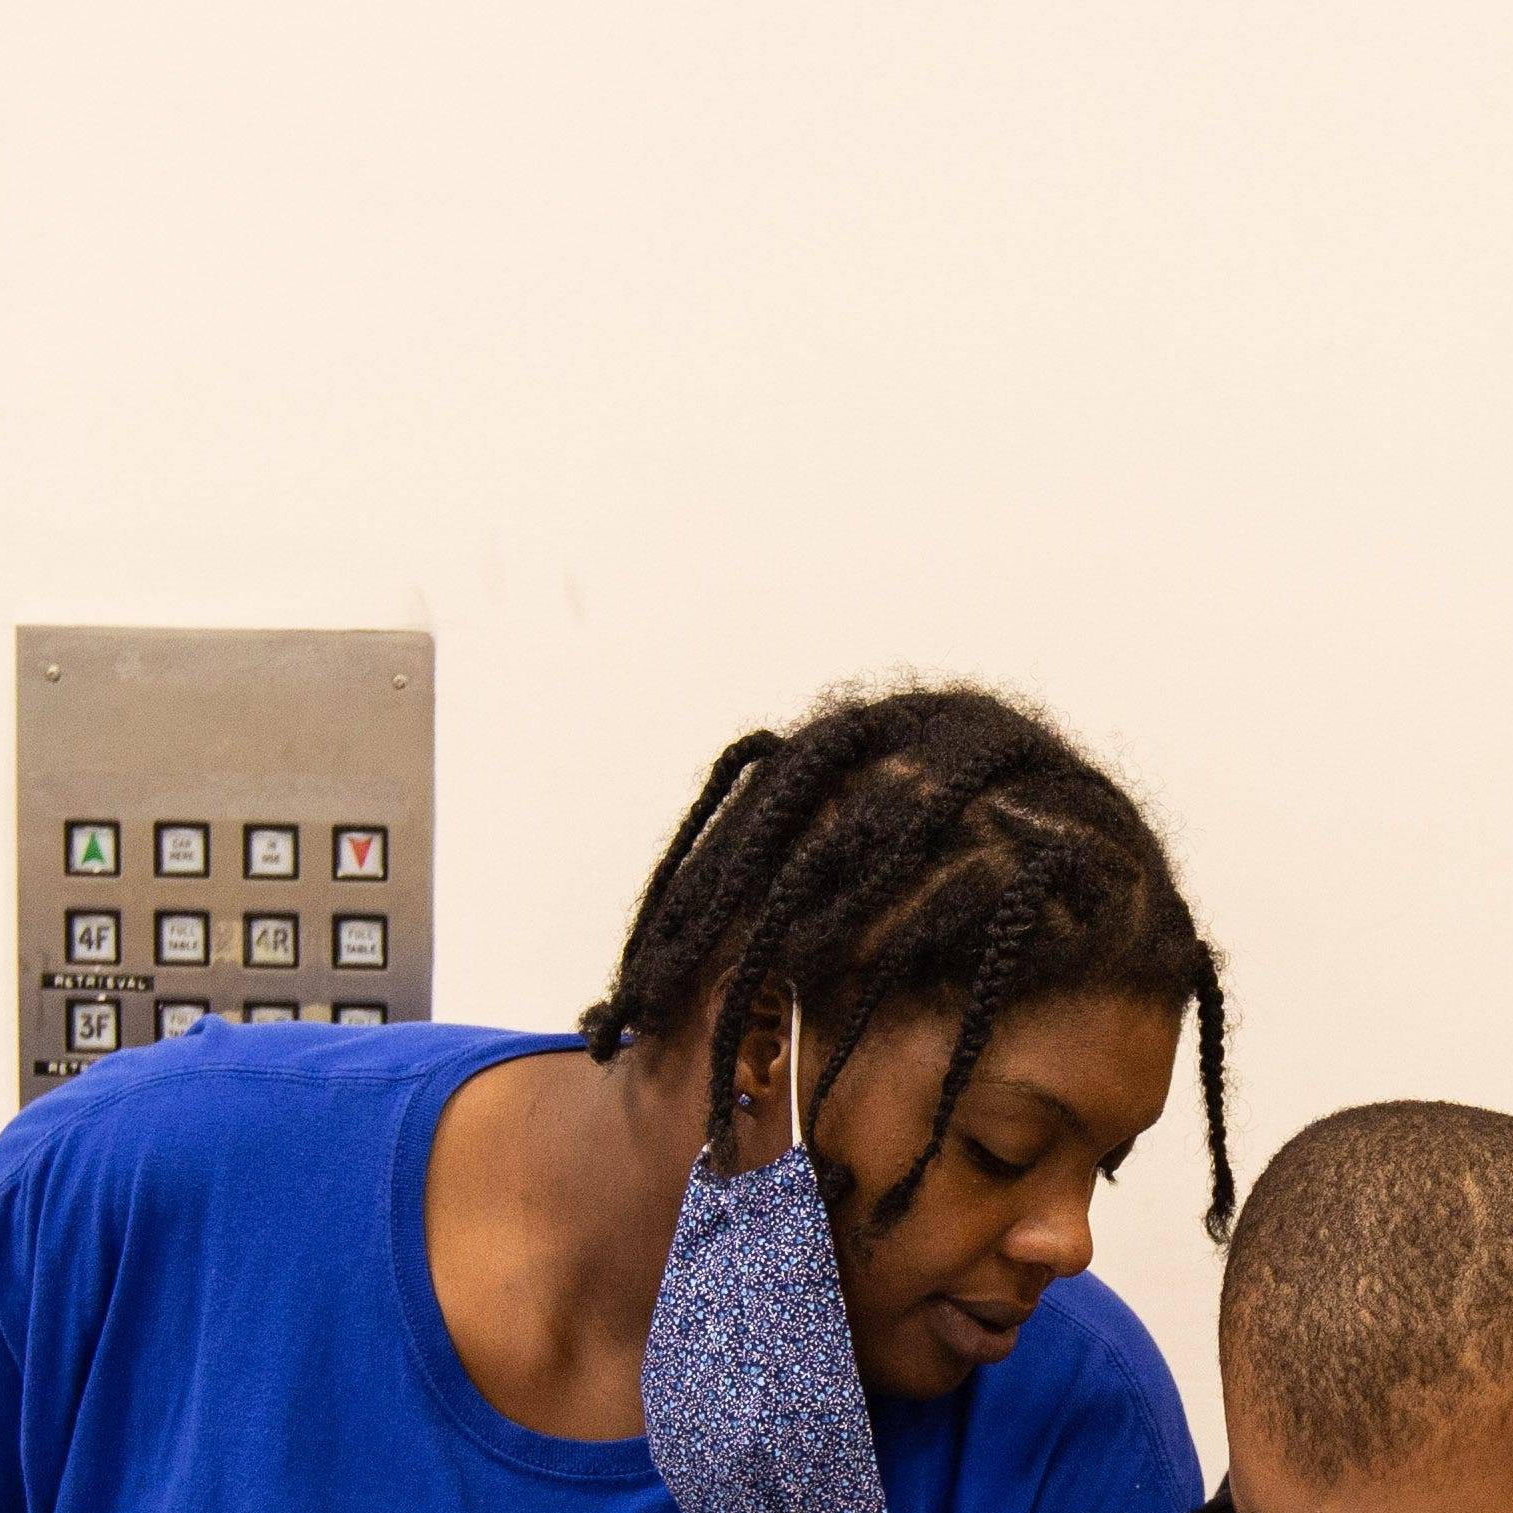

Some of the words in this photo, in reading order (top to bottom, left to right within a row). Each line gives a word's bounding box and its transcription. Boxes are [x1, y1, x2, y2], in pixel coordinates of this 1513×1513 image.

[78, 926, 110, 951] 4F
[255, 927, 290, 954] 4R
[53, 976, 147, 991] RETRIEVAL
[78, 1012, 111, 1041] 3F
